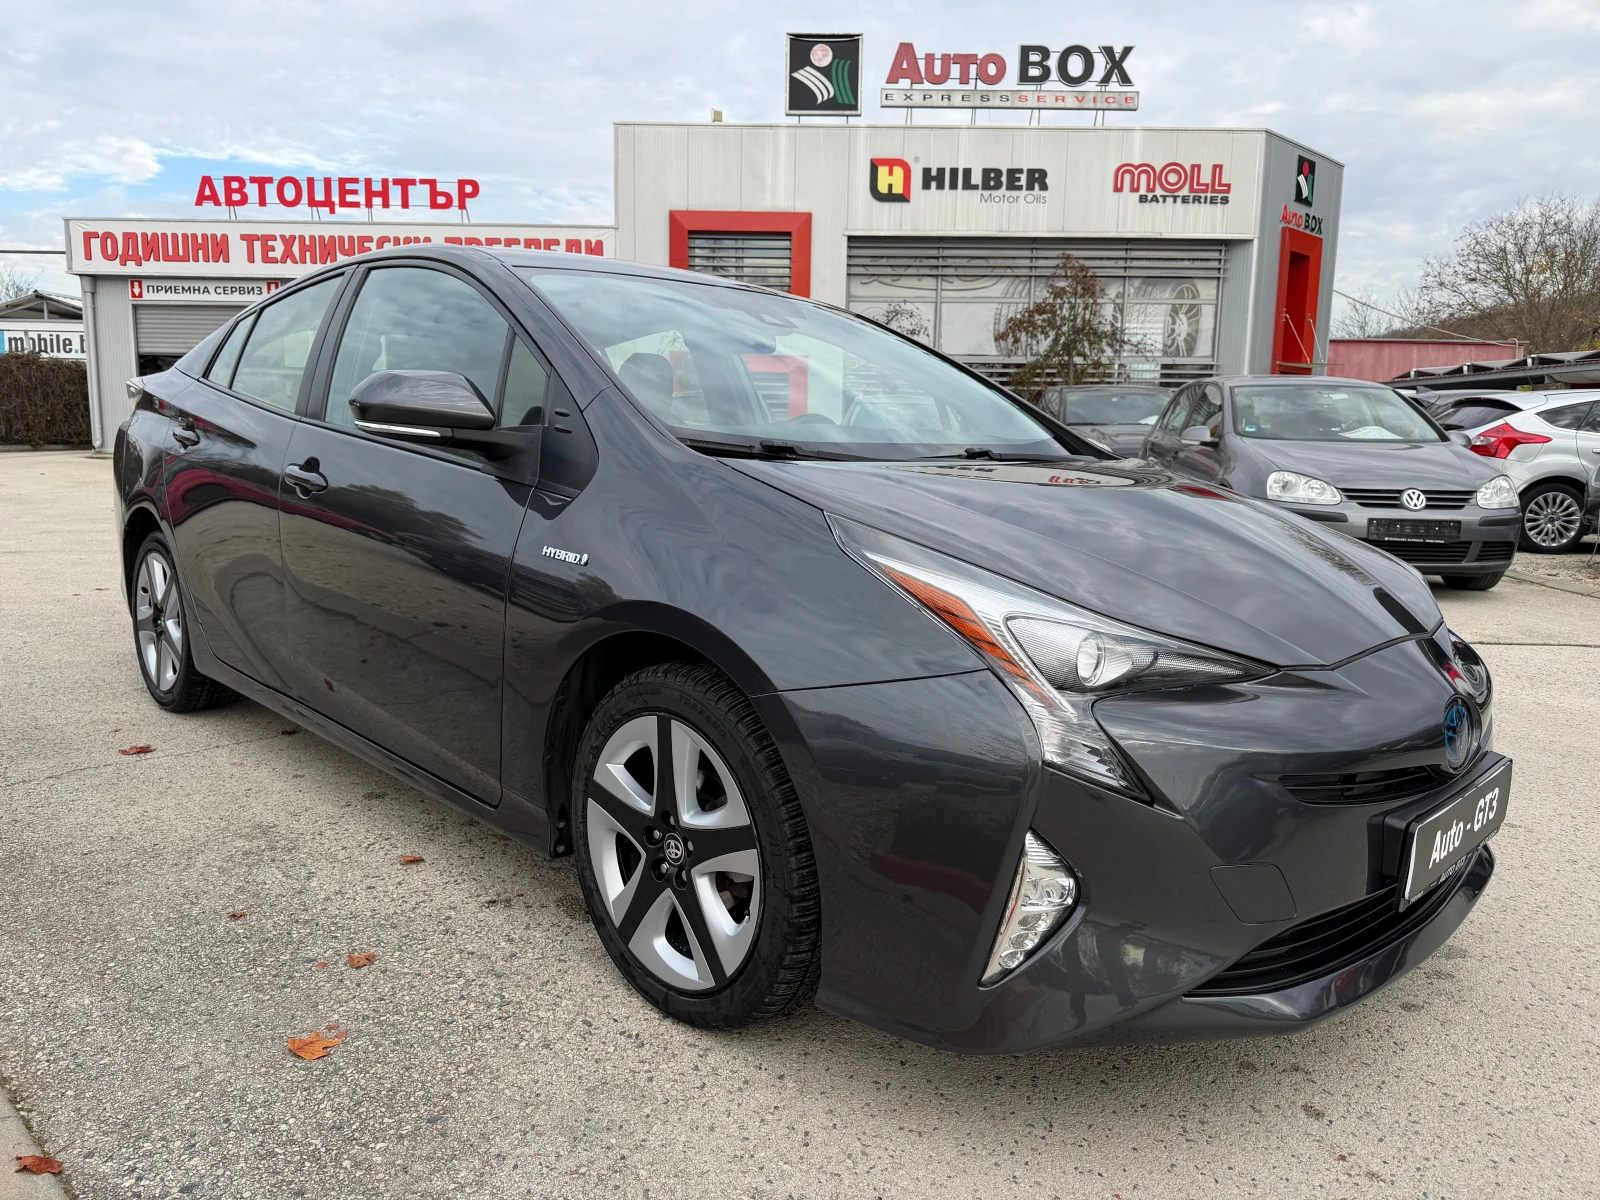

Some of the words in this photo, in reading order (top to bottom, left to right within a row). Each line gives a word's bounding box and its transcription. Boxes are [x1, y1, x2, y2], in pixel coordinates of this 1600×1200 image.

[1017, 44, 1137, 87] BOX
[921, 167, 1049, 191] HILBER
[194, 175, 480, 214] АВТОЦЕНТЪР
[980, 193, 1019, 204] Motor
[1023, 193, 1047, 204] Oils
[1139, 194, 1230, 205] BATTERIES
[1304, 212, 1323, 235] BOX
[83, 231, 230, 266] ГОДИШНИ
[146, 284, 211, 296] ПРИЕМНА
[214, 286, 263, 296] СЕРВИЗ
[542, 545, 581, 564] HYBRID
[1428, 819, 1464, 869] Auto
[1473, 787, 1500, 832] GT3
